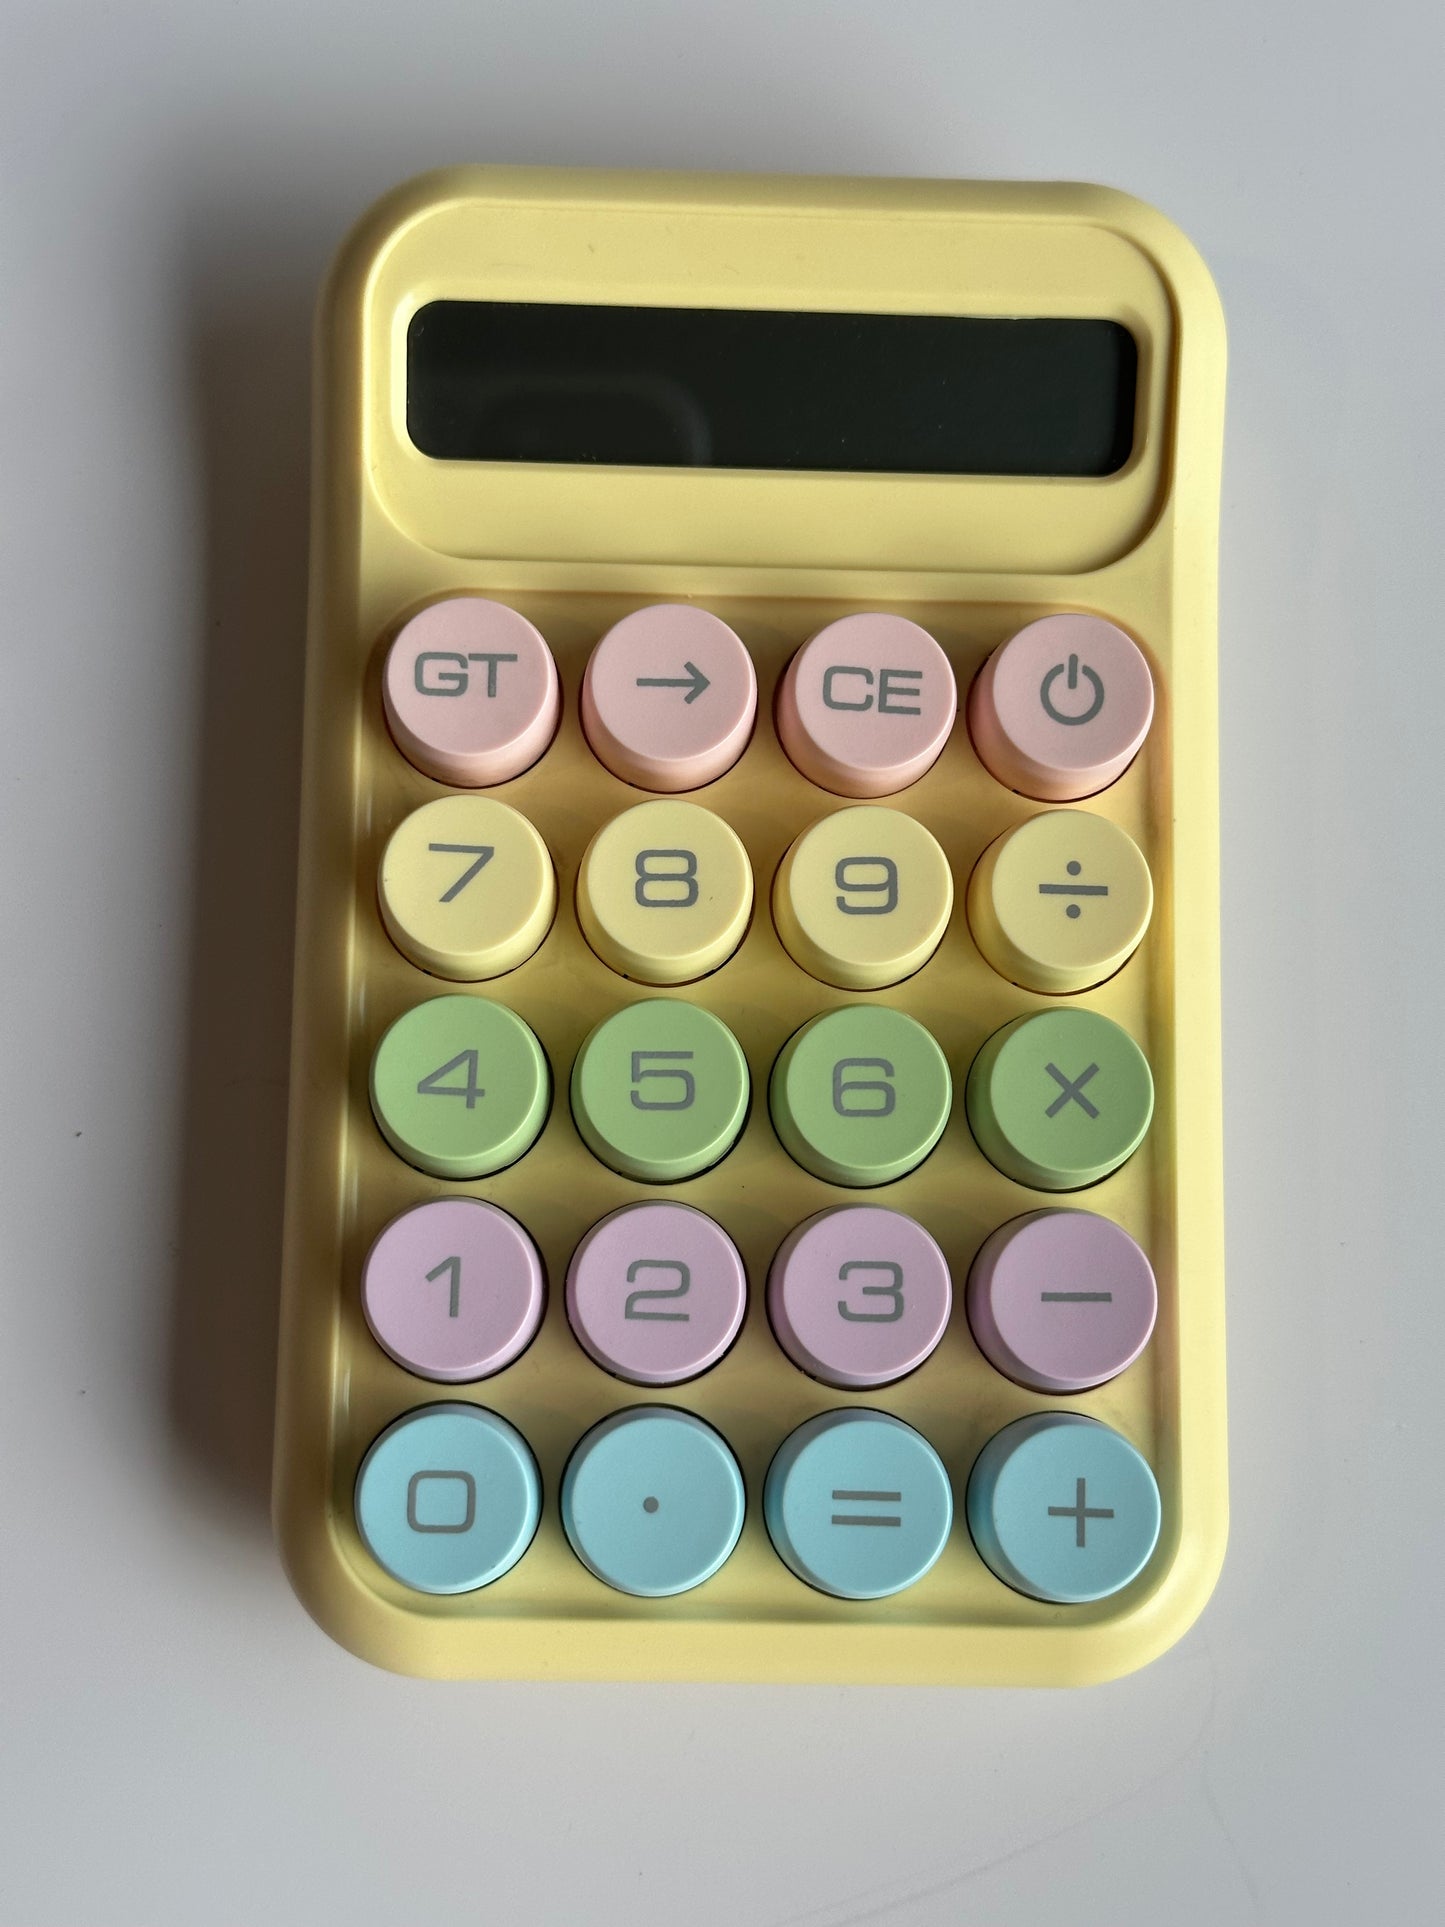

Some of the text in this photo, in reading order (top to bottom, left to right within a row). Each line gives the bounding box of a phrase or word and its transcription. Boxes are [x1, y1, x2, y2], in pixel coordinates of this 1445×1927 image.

[414, 651, 517, 698] GT
[823, 666, 923, 715] CE
[429, 843, 494, 903] 7
[635, 849, 699, 908] 8
[835, 857, 898, 915] 9
[418, 1050, 485, 1108] 4
[631, 1052, 695, 1110] 5
[833, 1058, 895, 1117] 6
[425, 1256, 461, 1318] 1
[625, 1260, 690, 1322] 2
[838, 1261, 904, 1323] 3
[407, 1470, 476, 1534] 0
